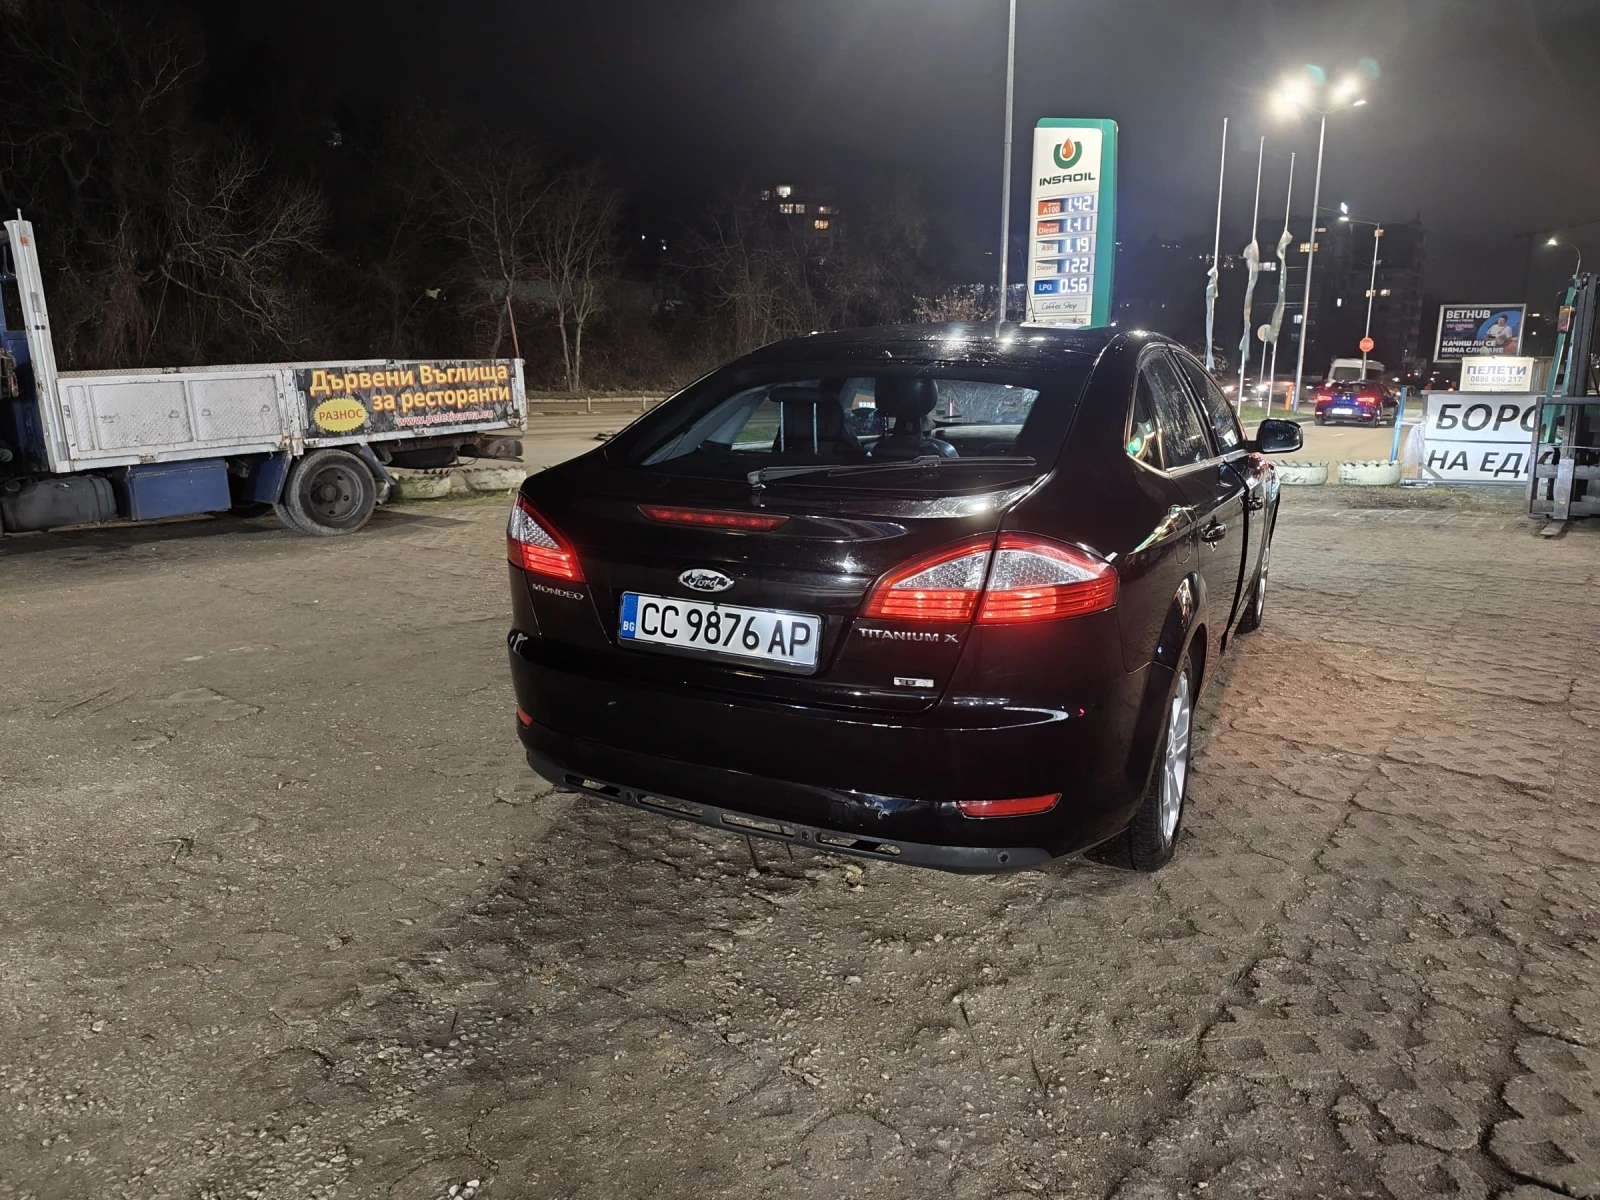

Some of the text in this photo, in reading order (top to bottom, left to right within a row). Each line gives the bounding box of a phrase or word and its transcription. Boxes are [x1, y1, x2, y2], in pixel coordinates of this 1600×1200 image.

[1039, 172, 1096, 187] INSAOIL
[1042, 195, 1092, 214] A100 1.42
[1038, 226, 1059, 235] Diesel
[1038, 277, 1088, 293] LPG 0.56
[1041, 301, 1078, 312] Coffee Shop
[1446, 310, 1491, 319] BETHUB
[1466, 365, 1527, 375] ПЕЛЕТИ
[310, 364, 509, 398] Дървени Въглища
[372, 385, 510, 413] за ресторанти
[318, 408, 363, 422] РАЗНОС
[396, 409, 494, 426] www.peletivarna.eu
[1427, 449, 1531, 478] НА ЕД
[688, 573, 720, 587] Ford
[532, 583, 584, 600] MONDEO
[623, 620, 635, 632] BG
[641, 602, 811, 657] CC 9876 AP
[858, 628, 959, 643] TITANIUM X
